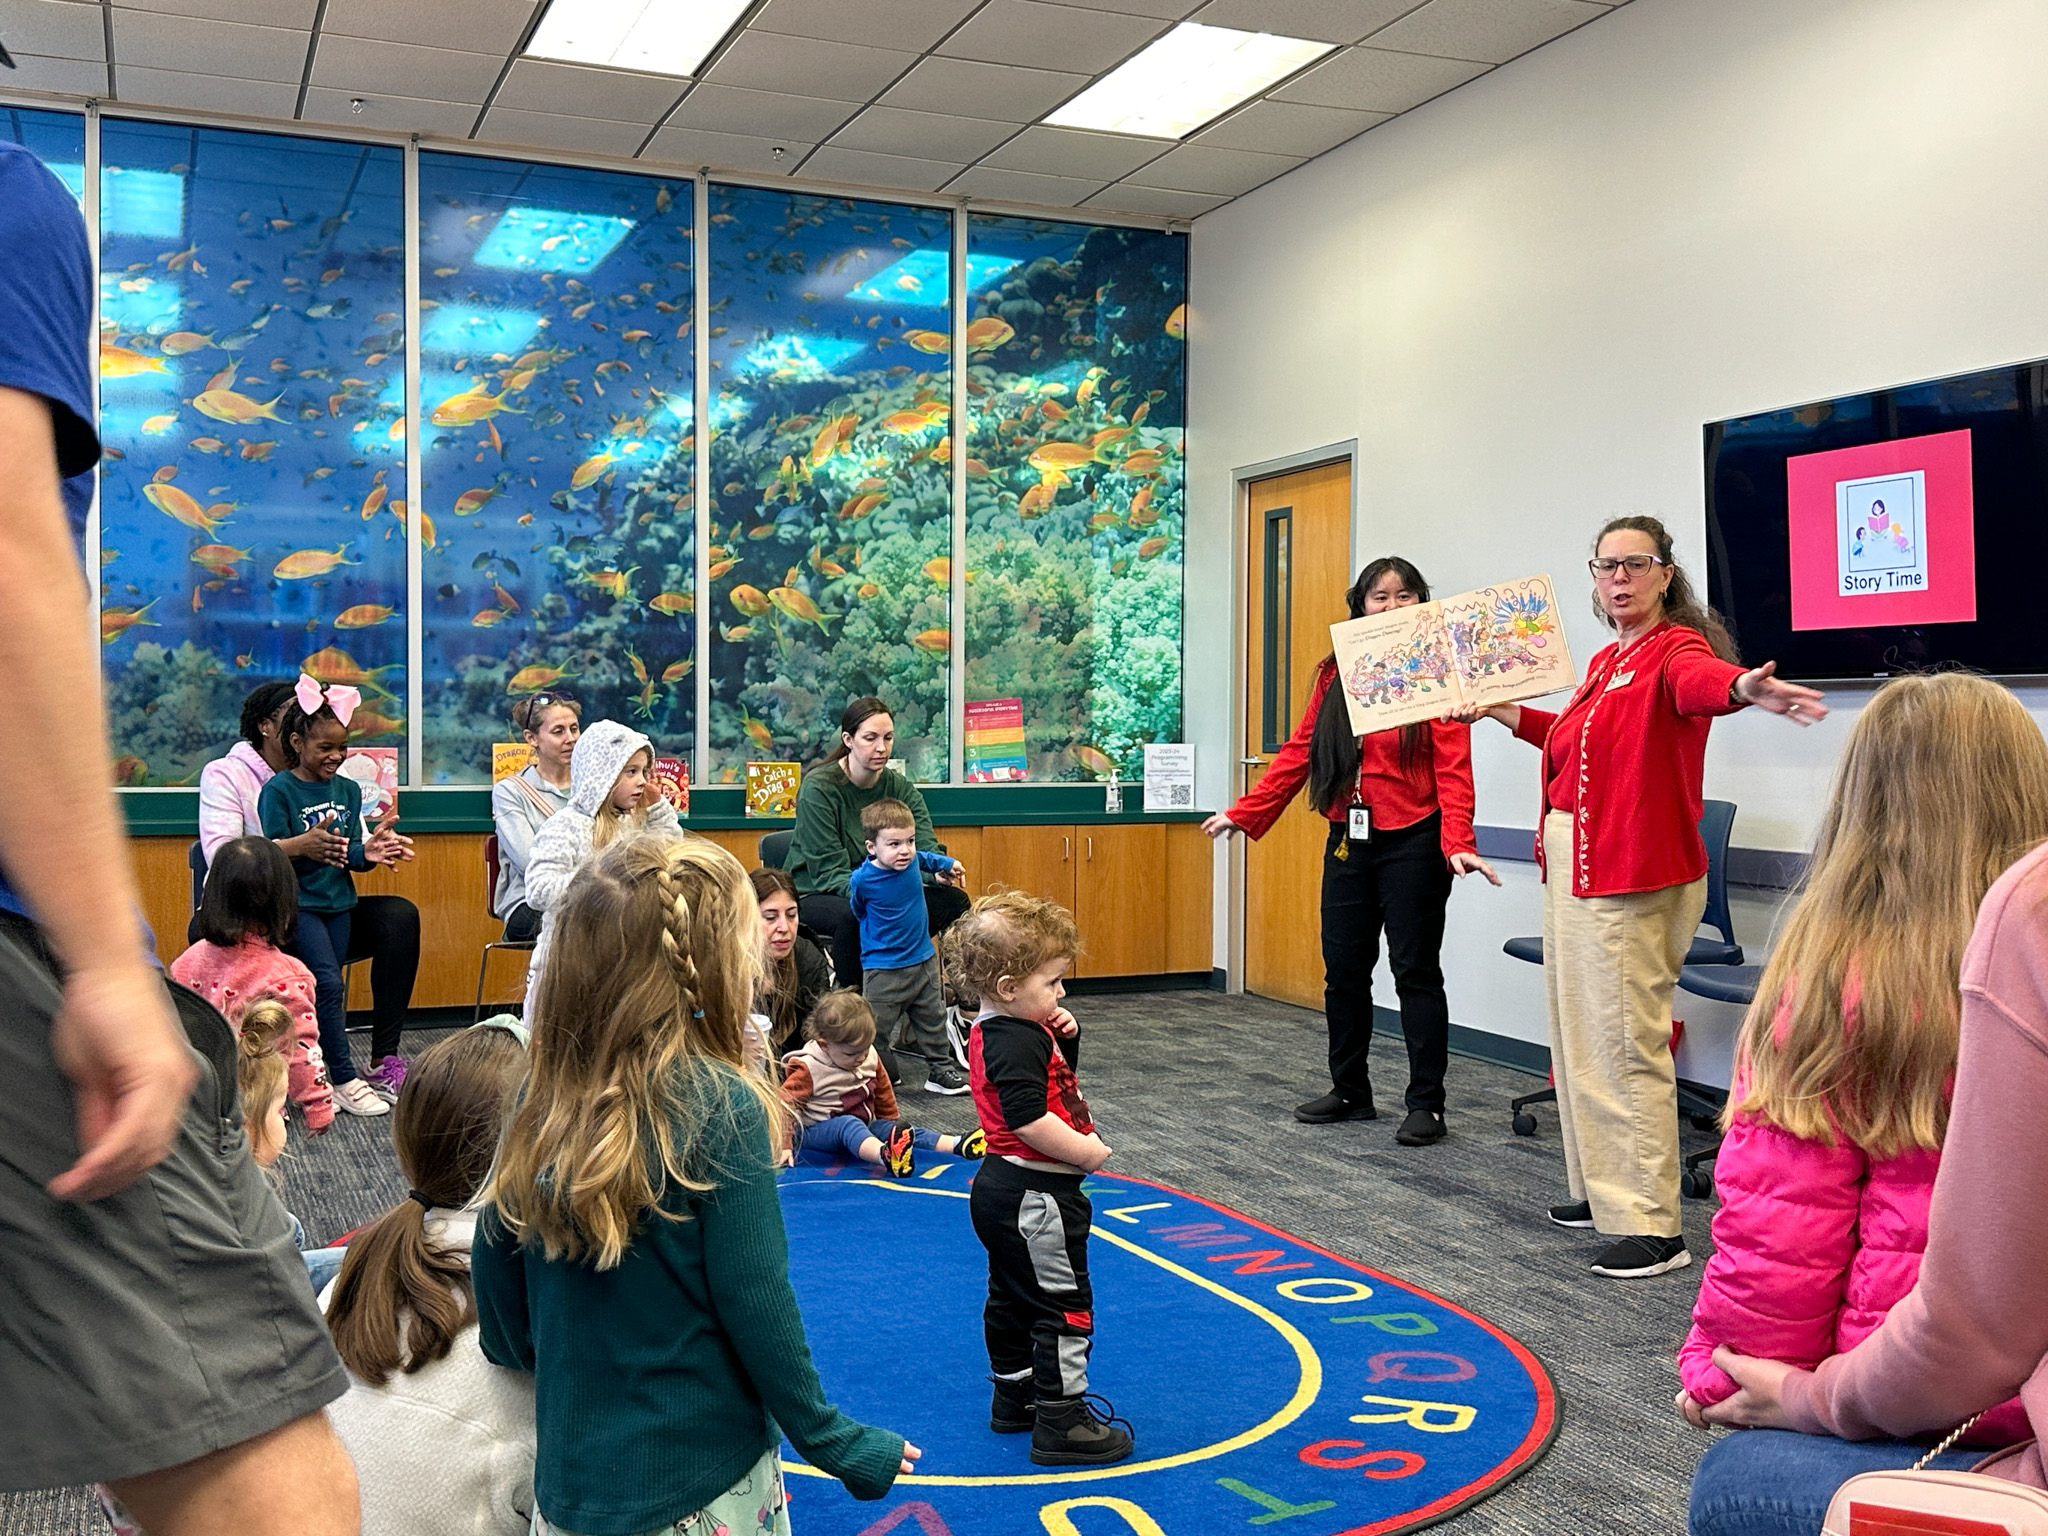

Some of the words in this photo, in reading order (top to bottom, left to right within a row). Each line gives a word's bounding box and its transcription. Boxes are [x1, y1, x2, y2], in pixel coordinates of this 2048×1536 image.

[1844, 575, 1882, 592] Story
[1886, 571, 1922, 587] Time
[968, 718, 973, 728] 1
[968, 733, 975, 743] 2
[495, 748, 527, 762] Dragon
[969, 748, 977, 757] 3
[752, 777, 796, 806] Dragon
[1103, 1202, 1172, 1224] L
[1206, 1249, 1315, 1275] N
[1275, 1277, 1374, 1304] O
[1329, 1312, 1440, 1336] P
[1366, 1351, 1479, 1384] Q
[1349, 1394, 1478, 1433] R
[1297, 1439, 1427, 1480] S
[1215, 1477, 1338, 1525] T
